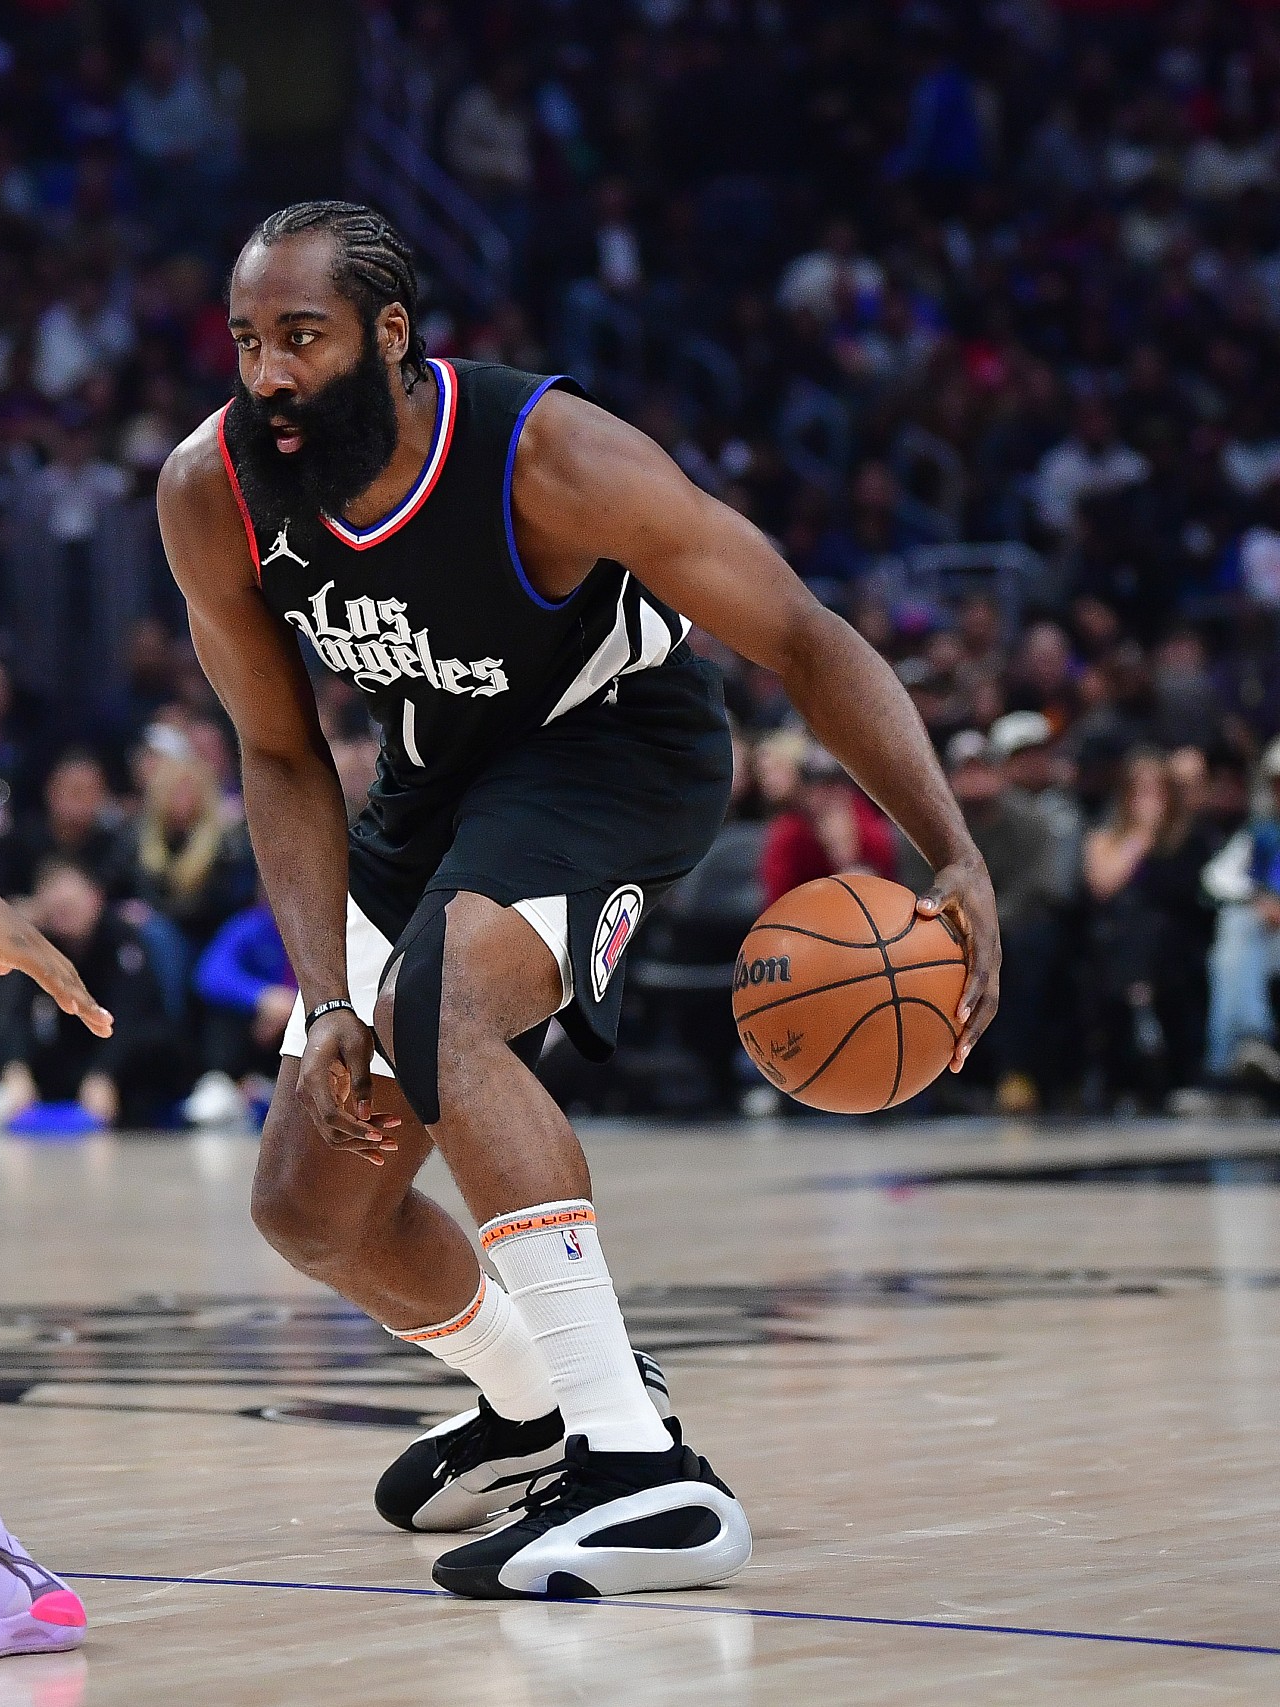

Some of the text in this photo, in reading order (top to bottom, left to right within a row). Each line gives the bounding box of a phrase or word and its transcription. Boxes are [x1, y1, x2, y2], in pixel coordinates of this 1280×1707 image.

[308, 580, 412, 644] Los
[284, 611, 509, 698] Angeles
[402, 698, 426, 768] 1
[541, 1211, 587, 1225] NBA
